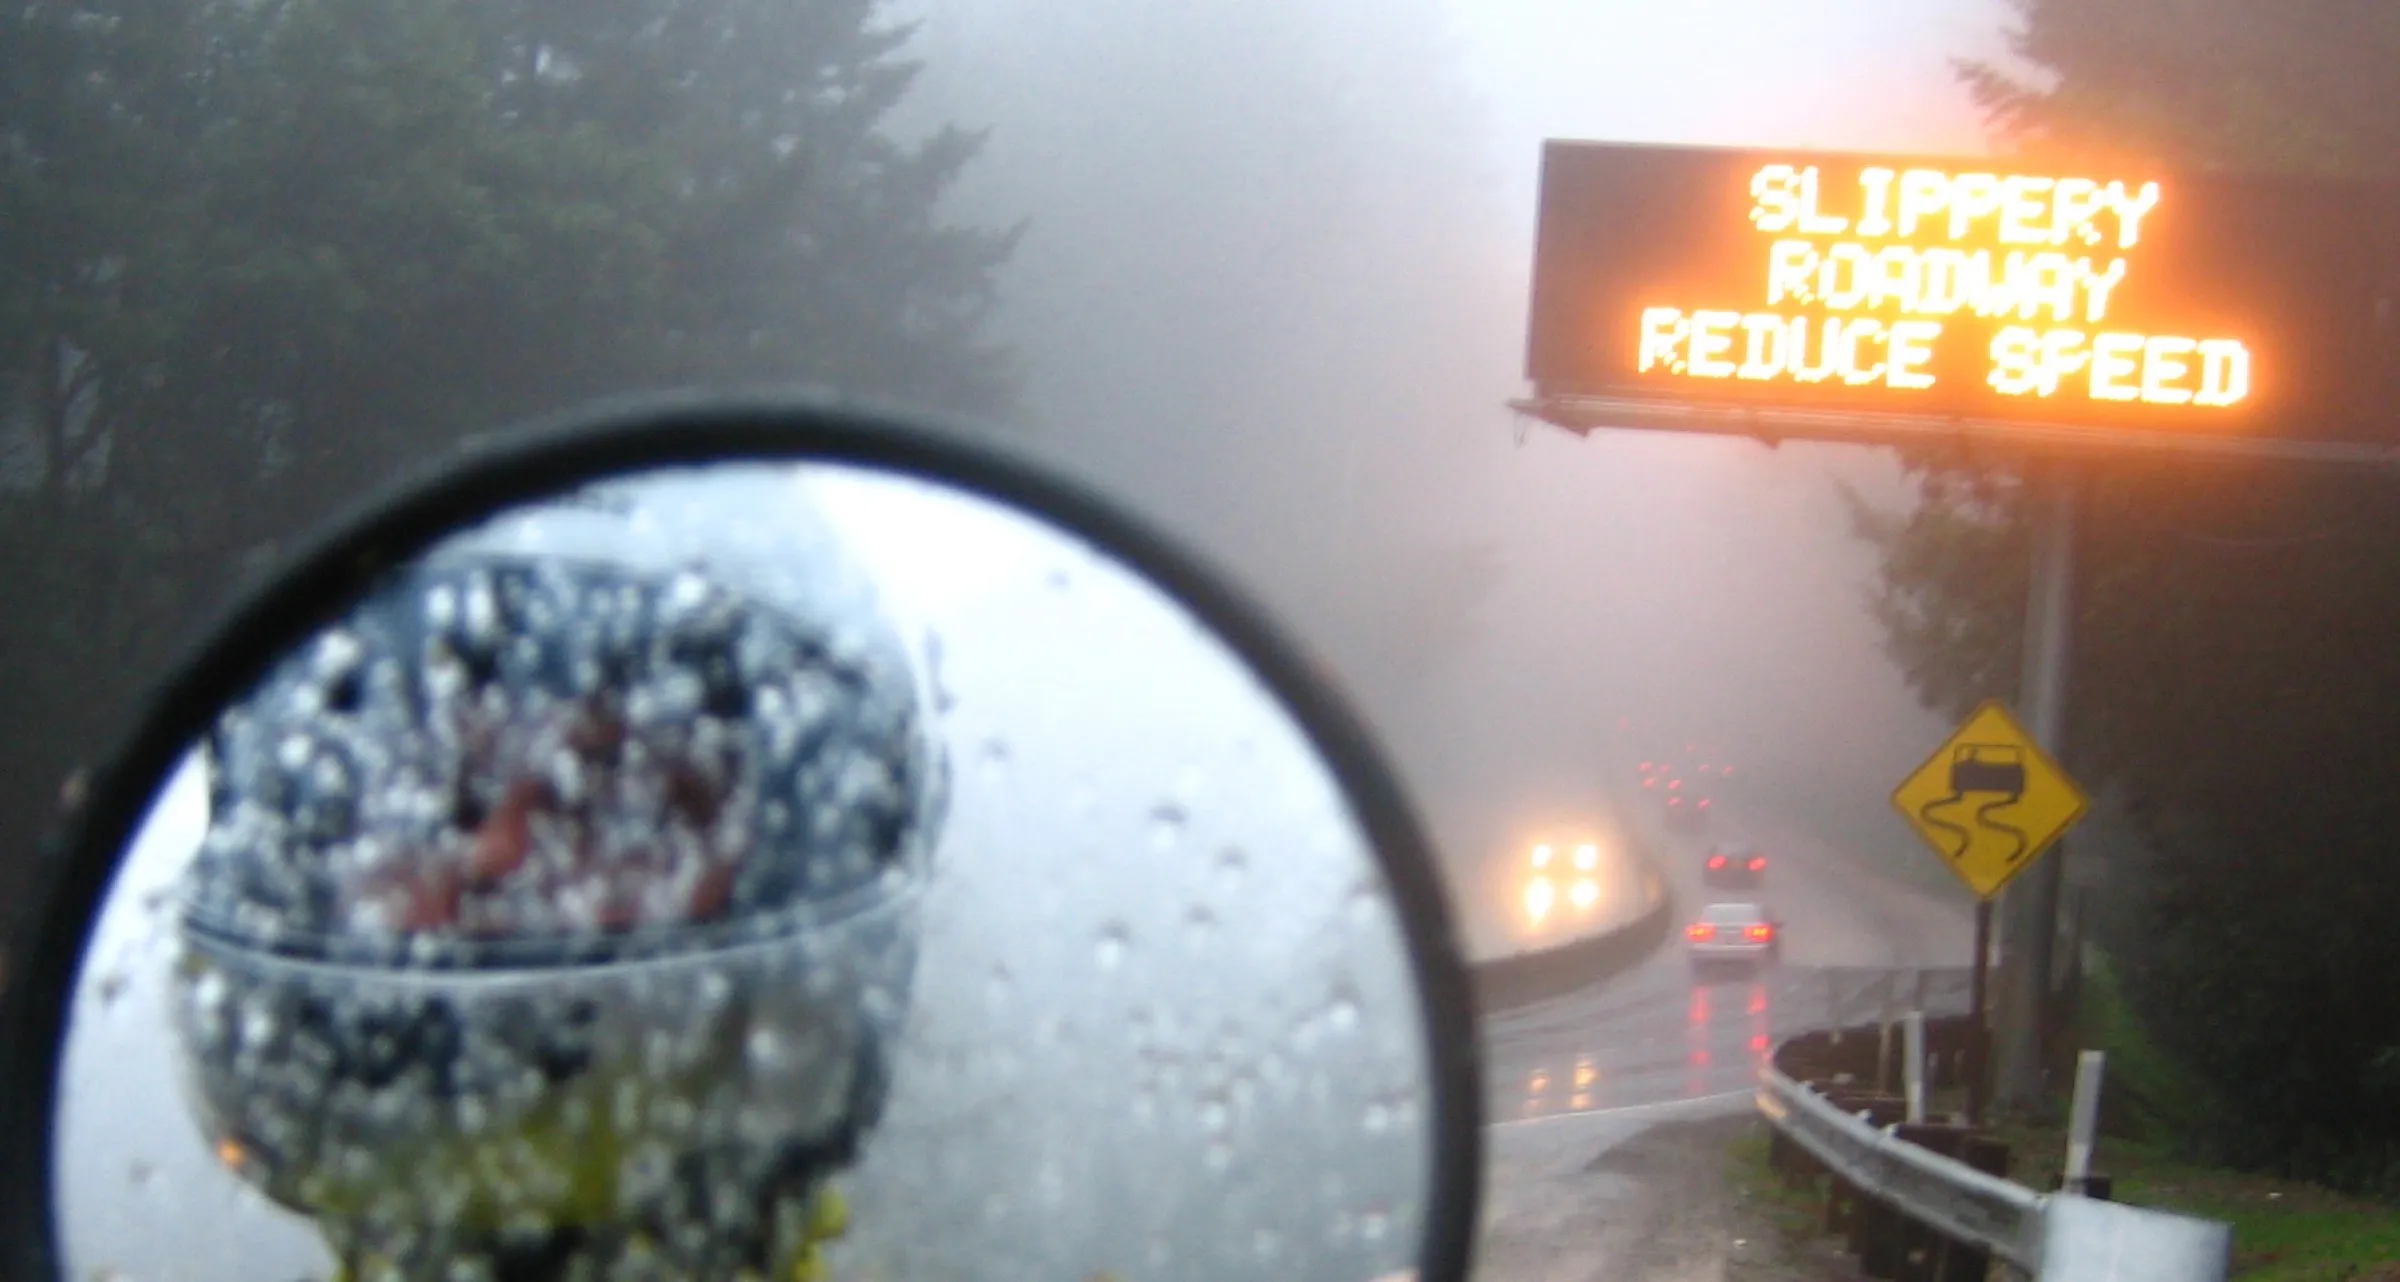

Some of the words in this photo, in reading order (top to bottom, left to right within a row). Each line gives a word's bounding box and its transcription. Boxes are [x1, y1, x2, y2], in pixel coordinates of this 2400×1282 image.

[1748, 164, 2160, 250] SLIPPERY
[1765, 239, 2127, 323] ROADWAY
[1638, 306, 1942, 389] REDUCE
[1986, 326, 2250, 407] SPEED
